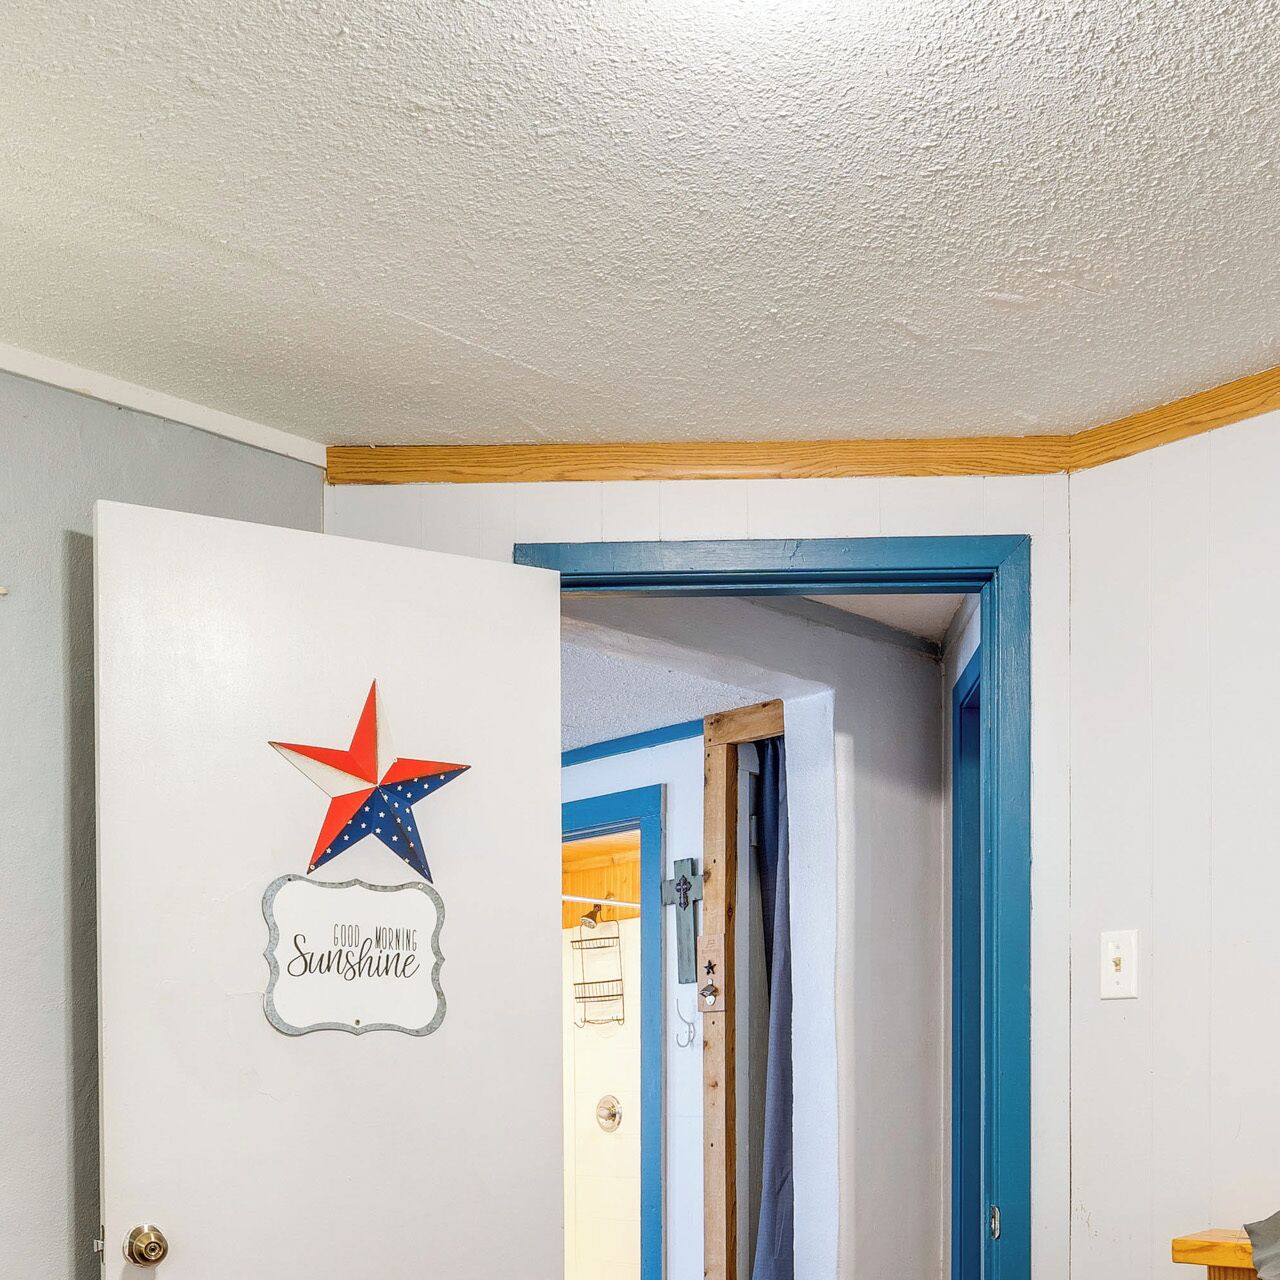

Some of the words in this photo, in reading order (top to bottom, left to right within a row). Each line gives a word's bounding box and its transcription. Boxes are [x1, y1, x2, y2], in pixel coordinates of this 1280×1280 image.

[333, 923, 360, 948] GOOD
[375, 926, 418, 951] MORNING
[287, 933, 420, 981] Sunshine
